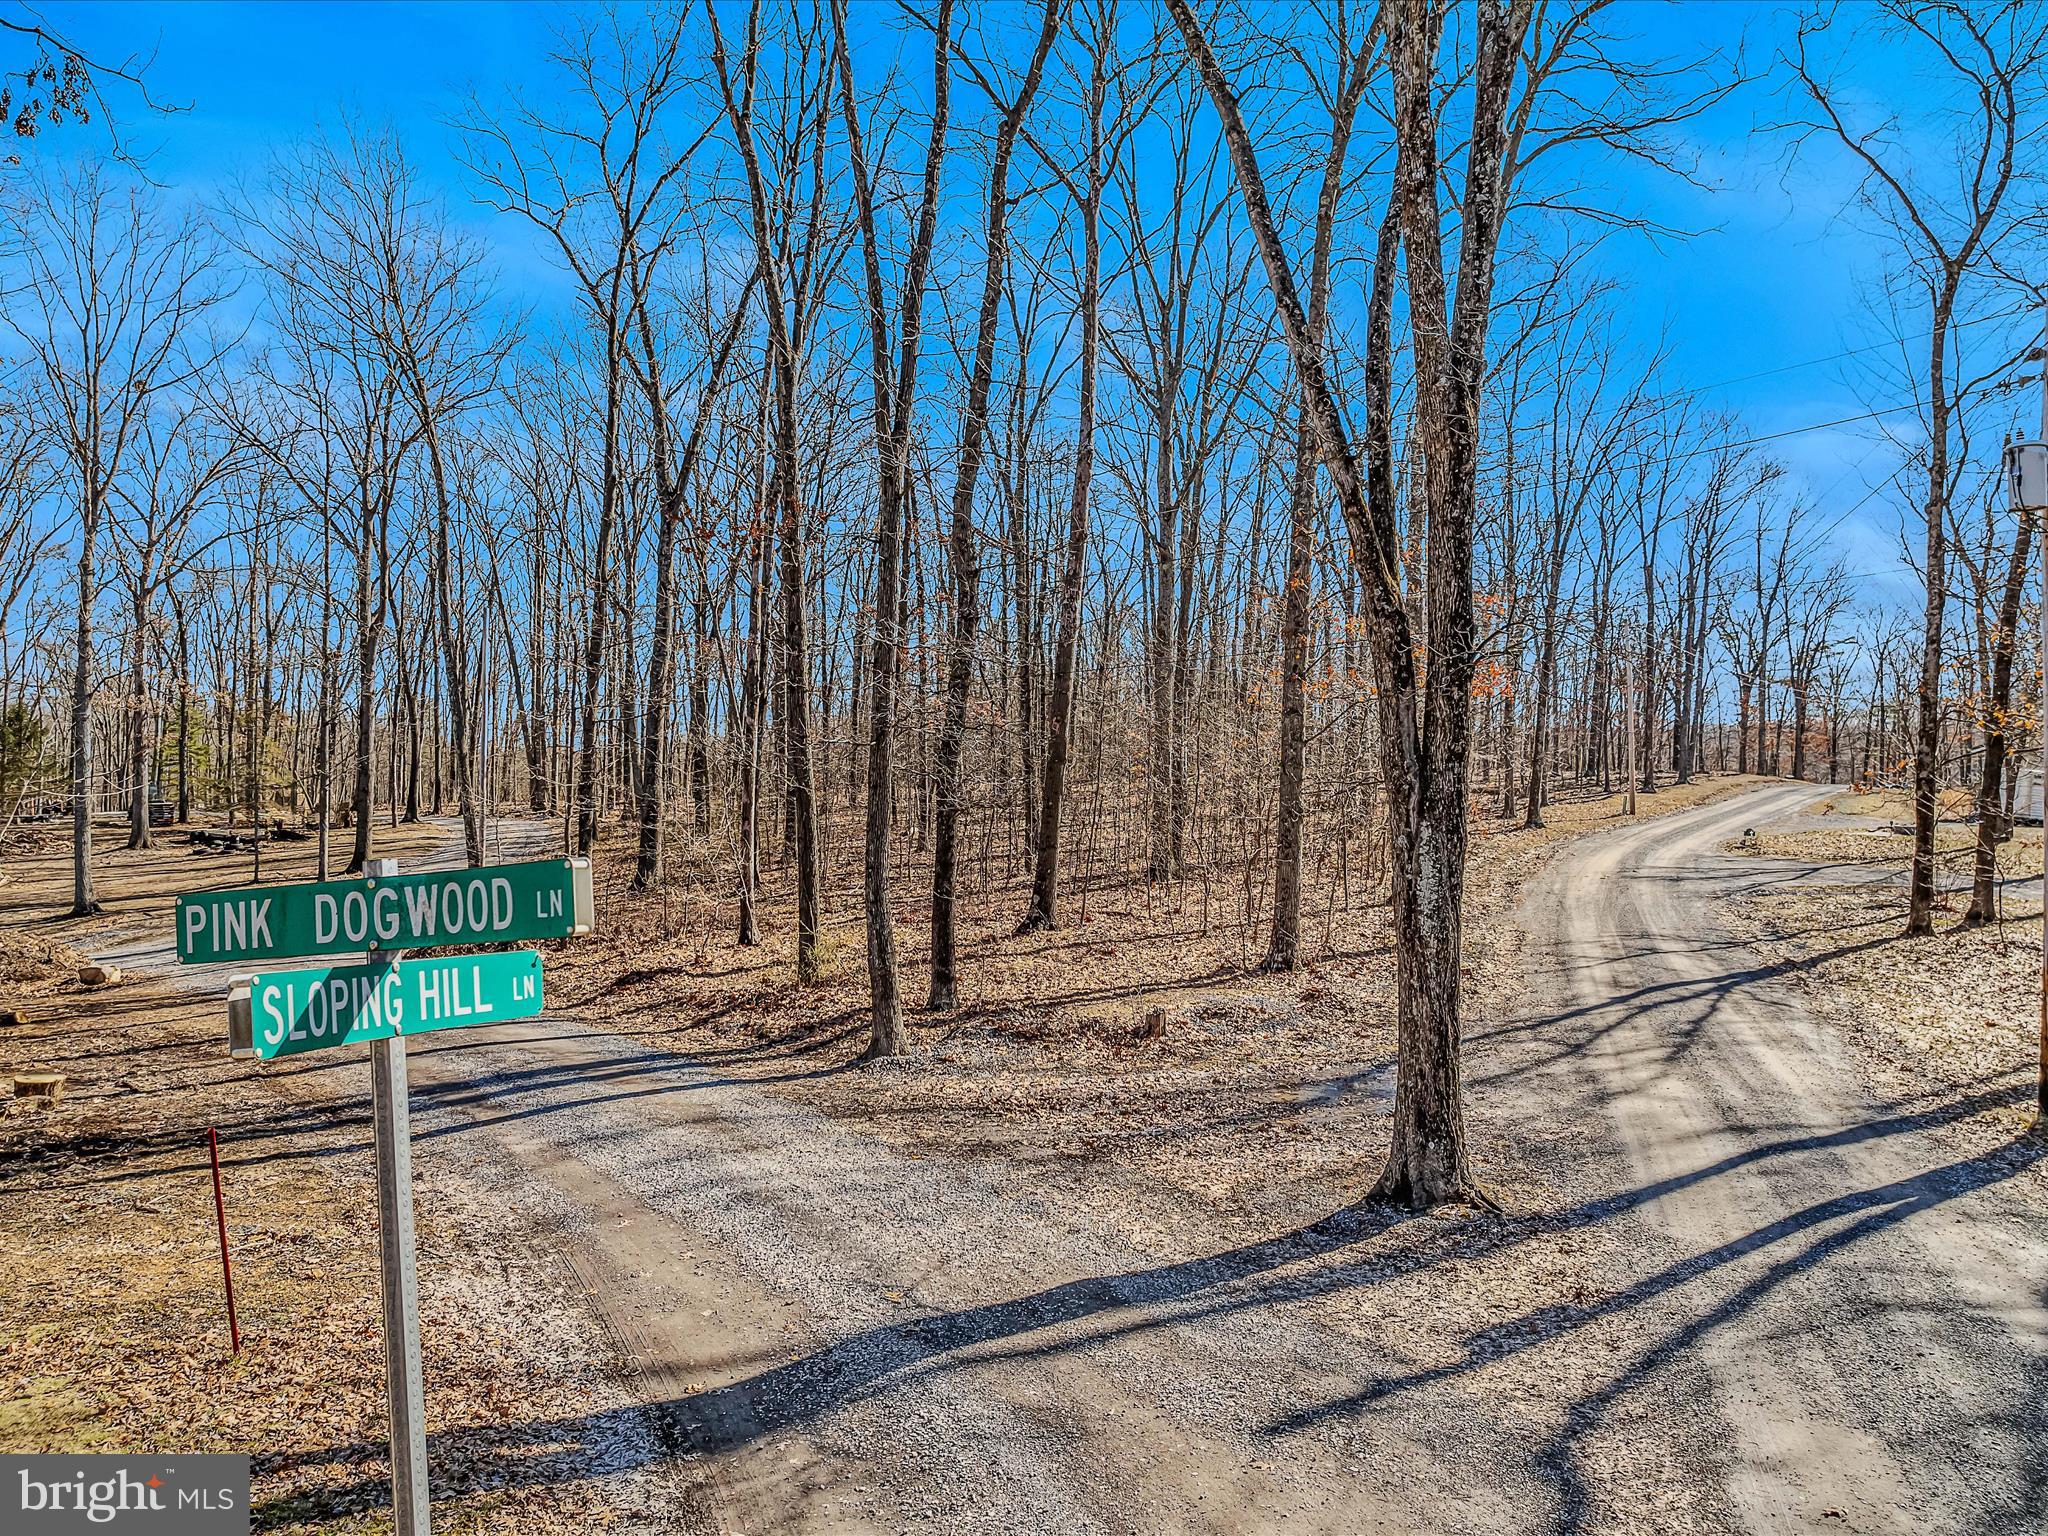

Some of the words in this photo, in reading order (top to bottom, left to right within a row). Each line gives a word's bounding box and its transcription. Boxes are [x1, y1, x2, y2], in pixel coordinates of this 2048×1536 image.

[186, 899, 273, 954] PINK
[315, 877, 513, 944] DOGWOOD
[536, 889, 562, 918] LN
[263, 971, 403, 1045] SLOPING
[418, 965, 493, 1020] HILL
[512, 974, 535, 1001] LN
